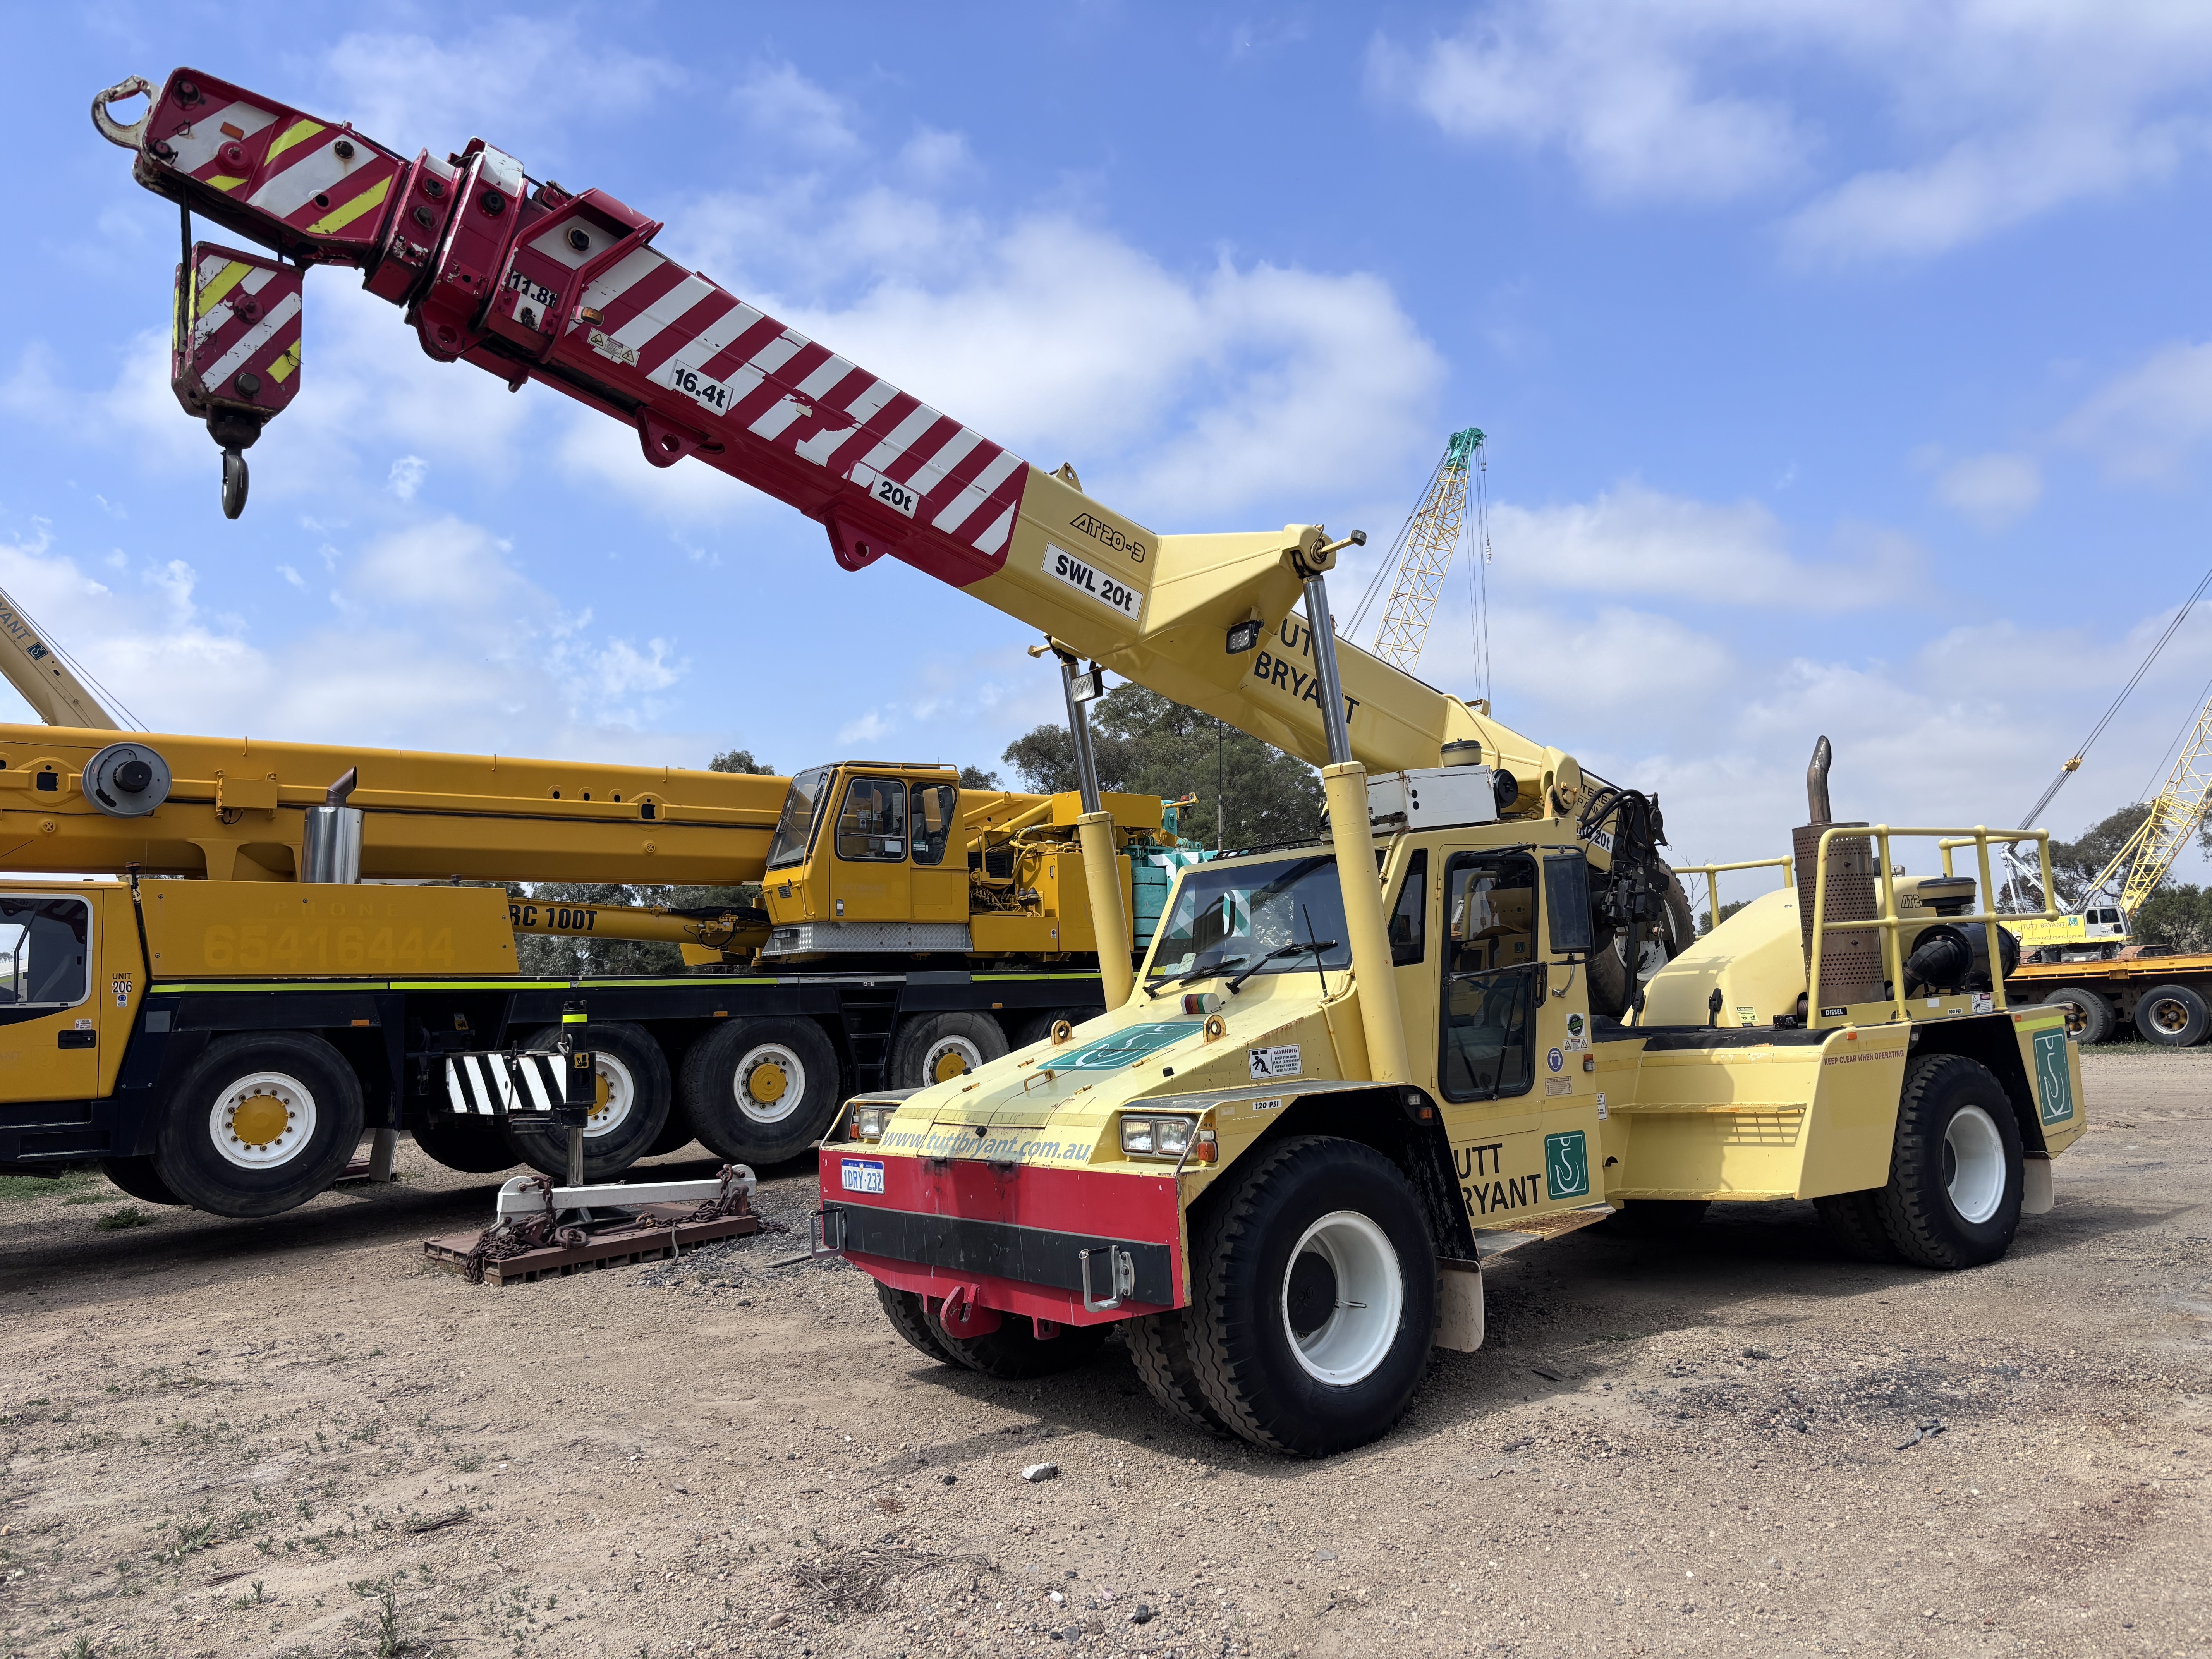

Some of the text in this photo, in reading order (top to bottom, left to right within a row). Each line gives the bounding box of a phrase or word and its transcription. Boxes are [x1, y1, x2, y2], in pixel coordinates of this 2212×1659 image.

[512, 273, 558, 308] 11.8t
[675, 368, 726, 409] 16.4t
[878, 481, 912, 512] 20t
[1069, 513, 1146, 563] AT20-3
[1055, 555, 1132, 611] SWL 20t
[1254, 651, 1360, 724] BRYAT
[1594, 830, 1610, 850] 20t
[1901, 894, 1922, 909] AT2
[546, 907, 598, 931] 100T
[112, 981, 132, 993] 206
[1824, 1050, 1904, 1065] KEEP CLEAR WHEN OPERATING
[882, 1131, 1091, 1161] www.tuttbryant.com.au
[1453, 1142, 1503, 1179] UTT
[1462, 1173, 1541, 1216] RYANT
